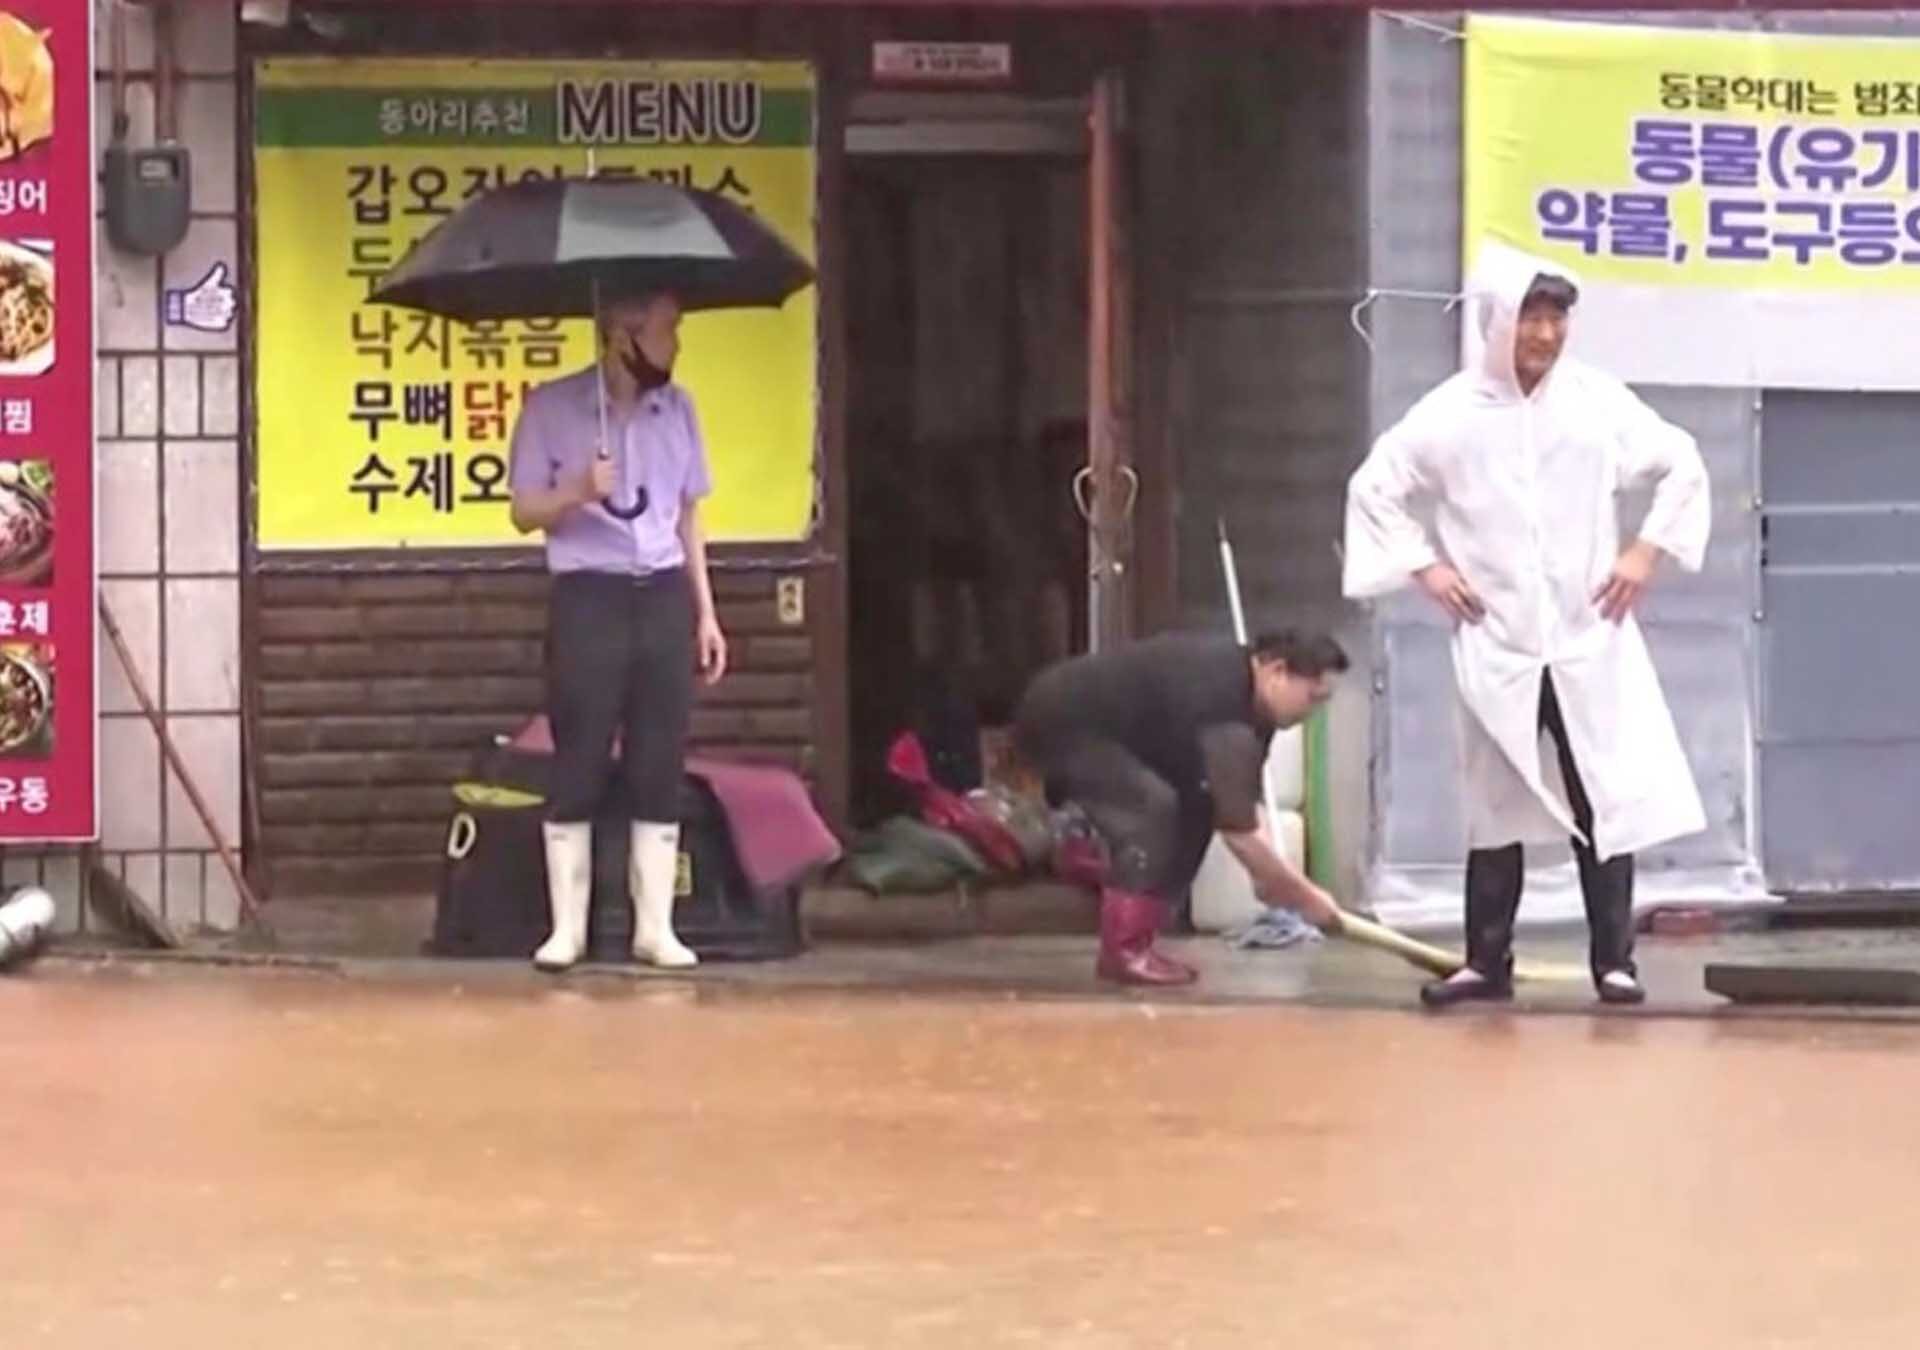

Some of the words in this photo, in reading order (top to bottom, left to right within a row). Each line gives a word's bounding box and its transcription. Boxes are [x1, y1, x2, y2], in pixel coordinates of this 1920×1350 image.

[557, 78, 761, 143] MENU
[1537, 188, 1688, 263] 약물,
[351, 311, 568, 369] 낙지볶음
